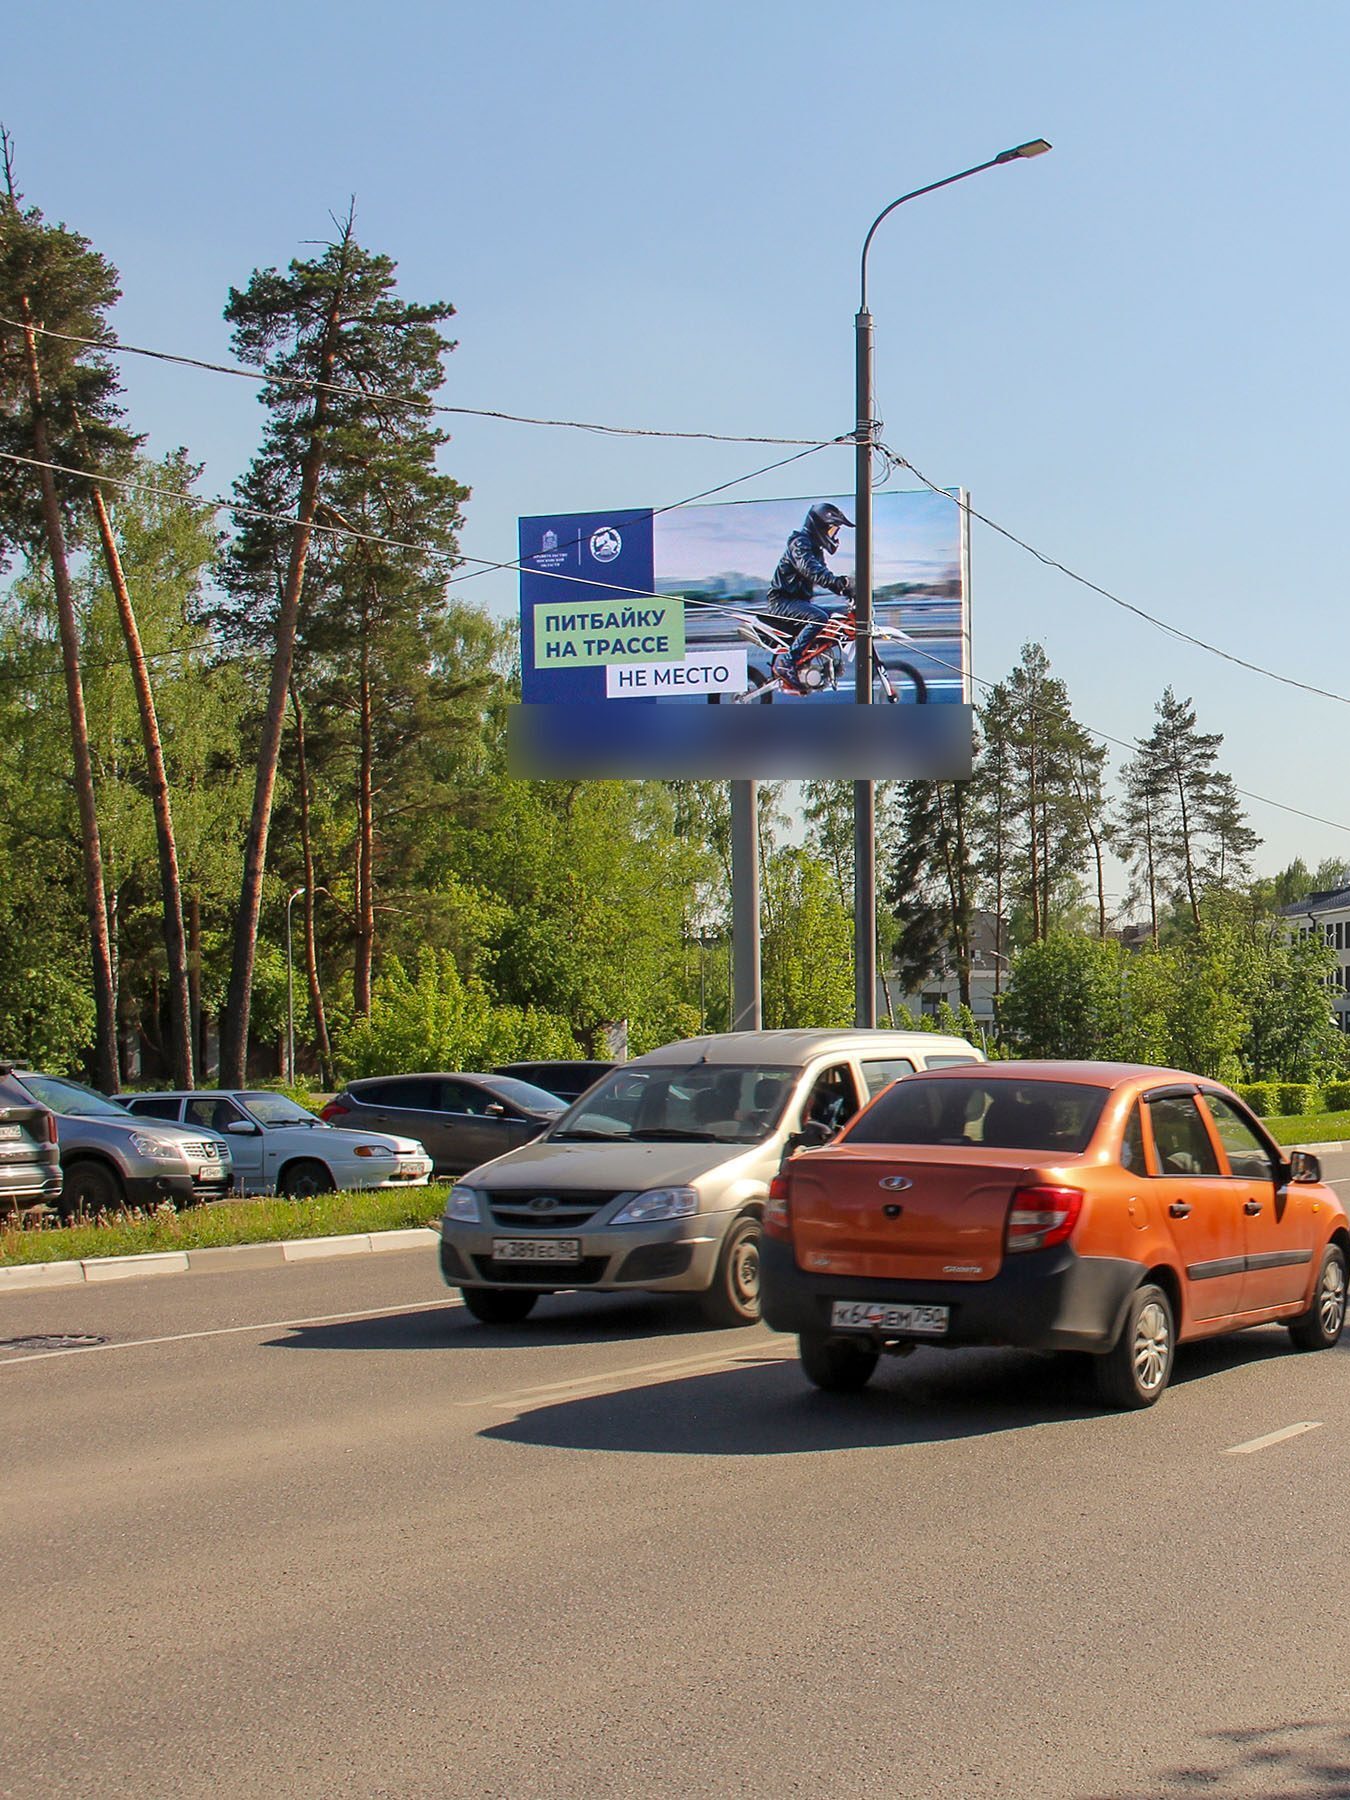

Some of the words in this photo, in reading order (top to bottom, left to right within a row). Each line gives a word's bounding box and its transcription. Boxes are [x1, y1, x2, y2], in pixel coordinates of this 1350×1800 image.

[546, 607, 666, 632] ПИТБАЙКУ
[546, 641, 577, 658] НА
[583, 636, 669, 656] ТРАССЕ
[619, 669, 647, 687] НЕ
[654, 666, 729, 685] МЕСТО
